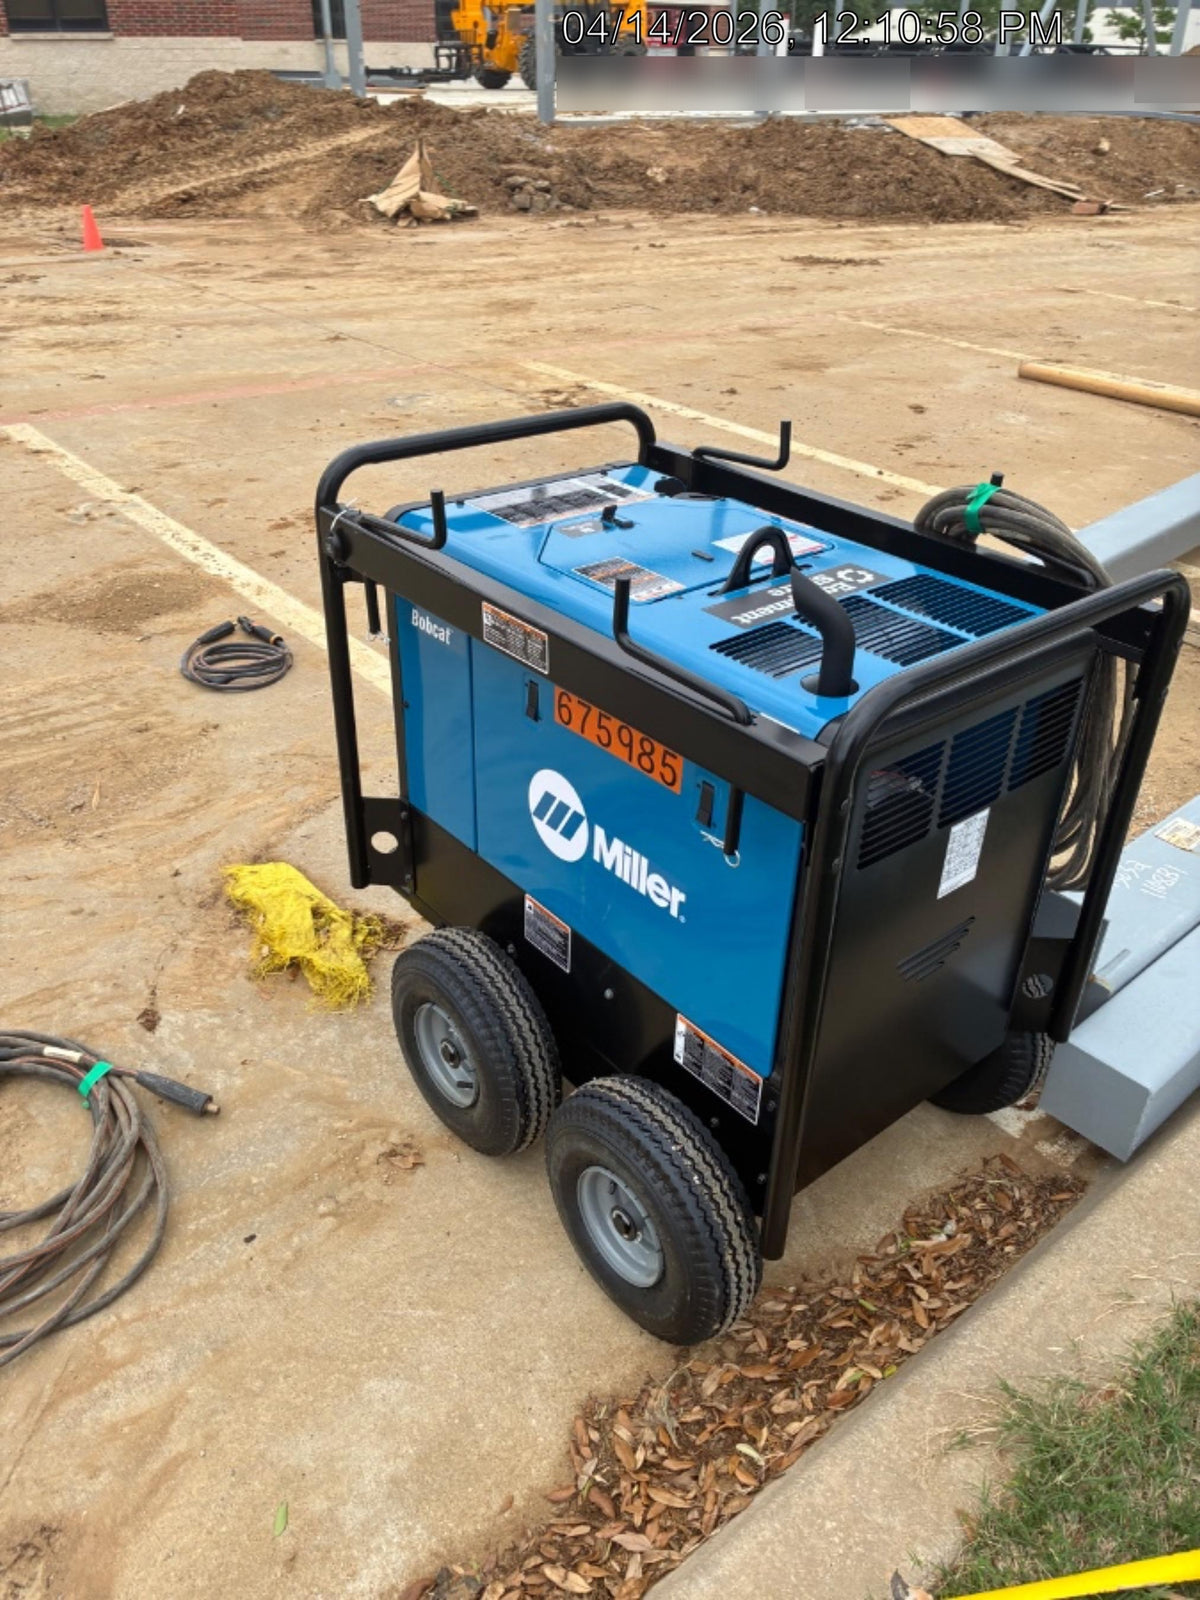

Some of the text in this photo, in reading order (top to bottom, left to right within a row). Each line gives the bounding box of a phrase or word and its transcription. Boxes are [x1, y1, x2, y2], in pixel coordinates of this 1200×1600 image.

[411, 608, 451, 645] Bobcat
[557, 690, 678, 787] 675985
[593, 824, 687, 919] Miller
